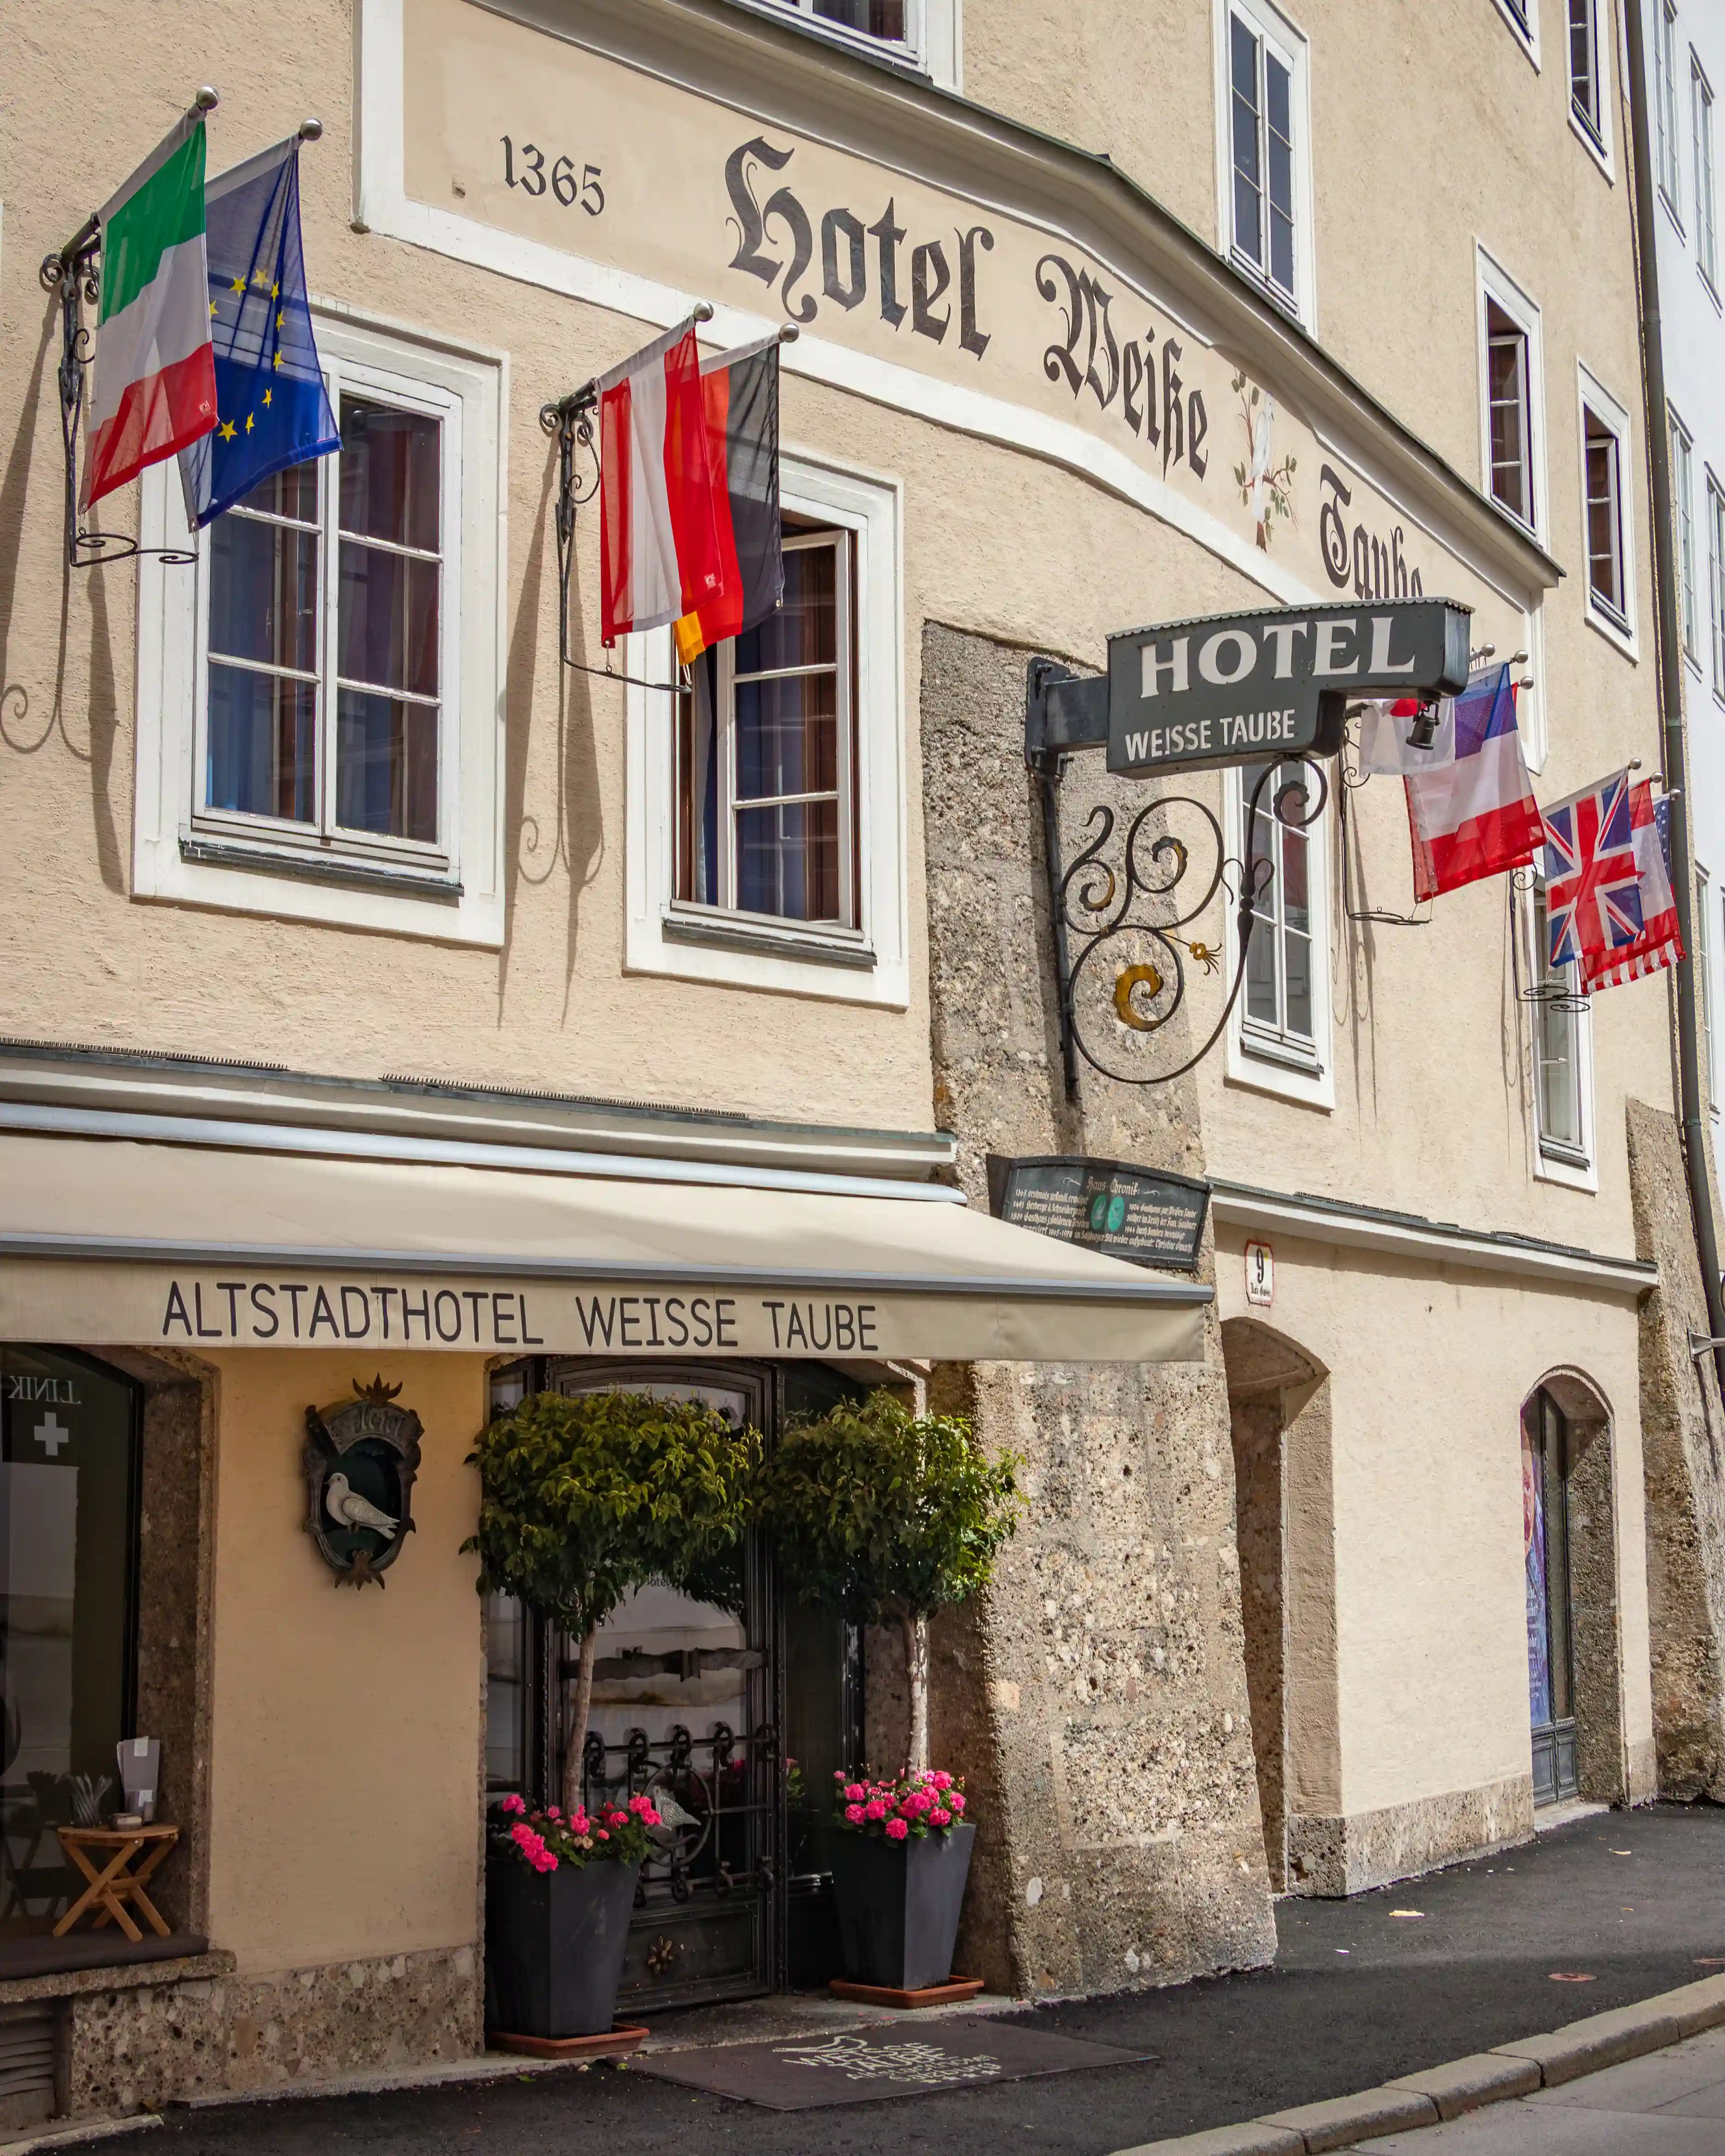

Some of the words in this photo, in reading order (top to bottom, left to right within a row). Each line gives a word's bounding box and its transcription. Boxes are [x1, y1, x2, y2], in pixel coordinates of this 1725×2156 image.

[500, 135, 605, 216] 1365
[725, 136, 994, 361] Hotel
[1139, 617, 1415, 698] HOTEL
[1125, 720, 1212, 762] WEISSE
[1219, 709, 1295, 746] TAUBE
[1256, 1248, 1264, 1284] 9
[162, 1281, 544, 1345] ALTSTADTHOTEL
[576, 1296, 738, 1347] WEISSE
[762, 1302, 879, 1351] TAUBE
[781, 2041, 945, 2066] WEISSE
[827, 2050, 960, 2071] TAUBE
